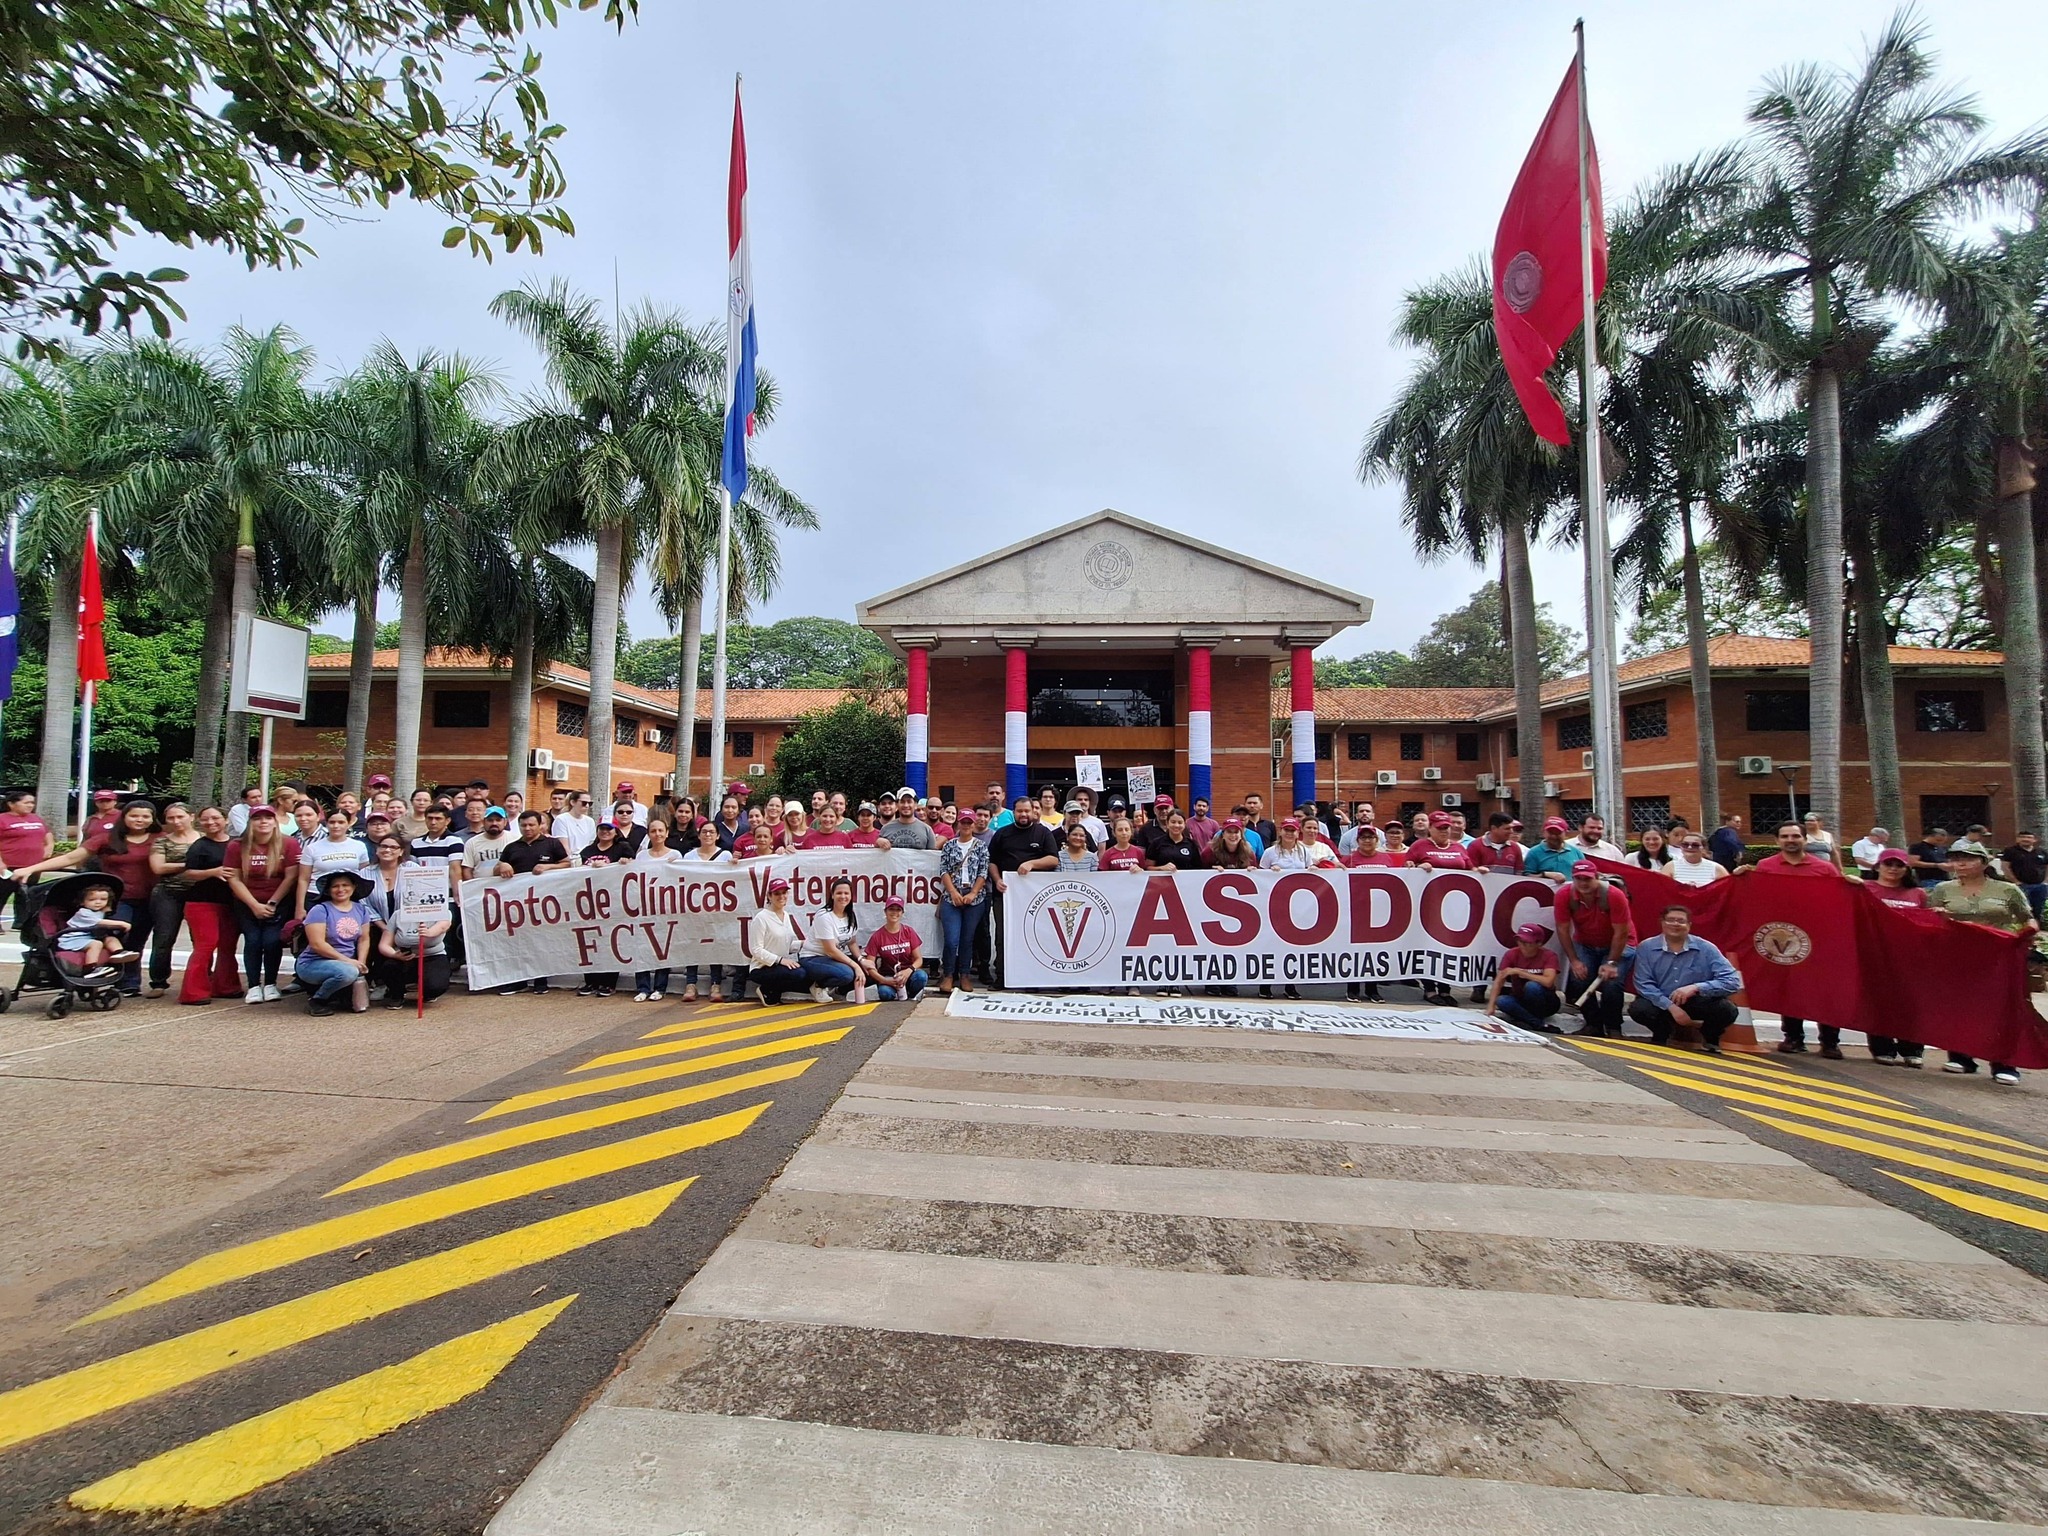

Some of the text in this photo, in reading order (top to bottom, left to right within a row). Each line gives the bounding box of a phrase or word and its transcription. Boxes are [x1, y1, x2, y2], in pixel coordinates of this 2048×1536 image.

[482, 886, 570, 936] Dpto.
[576, 877, 611, 920] de
[621, 872, 738, 917] Clínicas
[1028, 884, 1066, 916] Asociación
[1080, 885, 1110, 916] Docentes
[1125, 872, 1555, 949] ASODOC
[572, 920, 678, 967] FCV
[1051, 960, 1068, 970] FCV
[1072, 960, 1090, 970] UNA
[1121, 949, 1499, 982] FACULTAD DE CIENCIAS VETERINA
[982, 1003, 1142, 1019] Universidad
